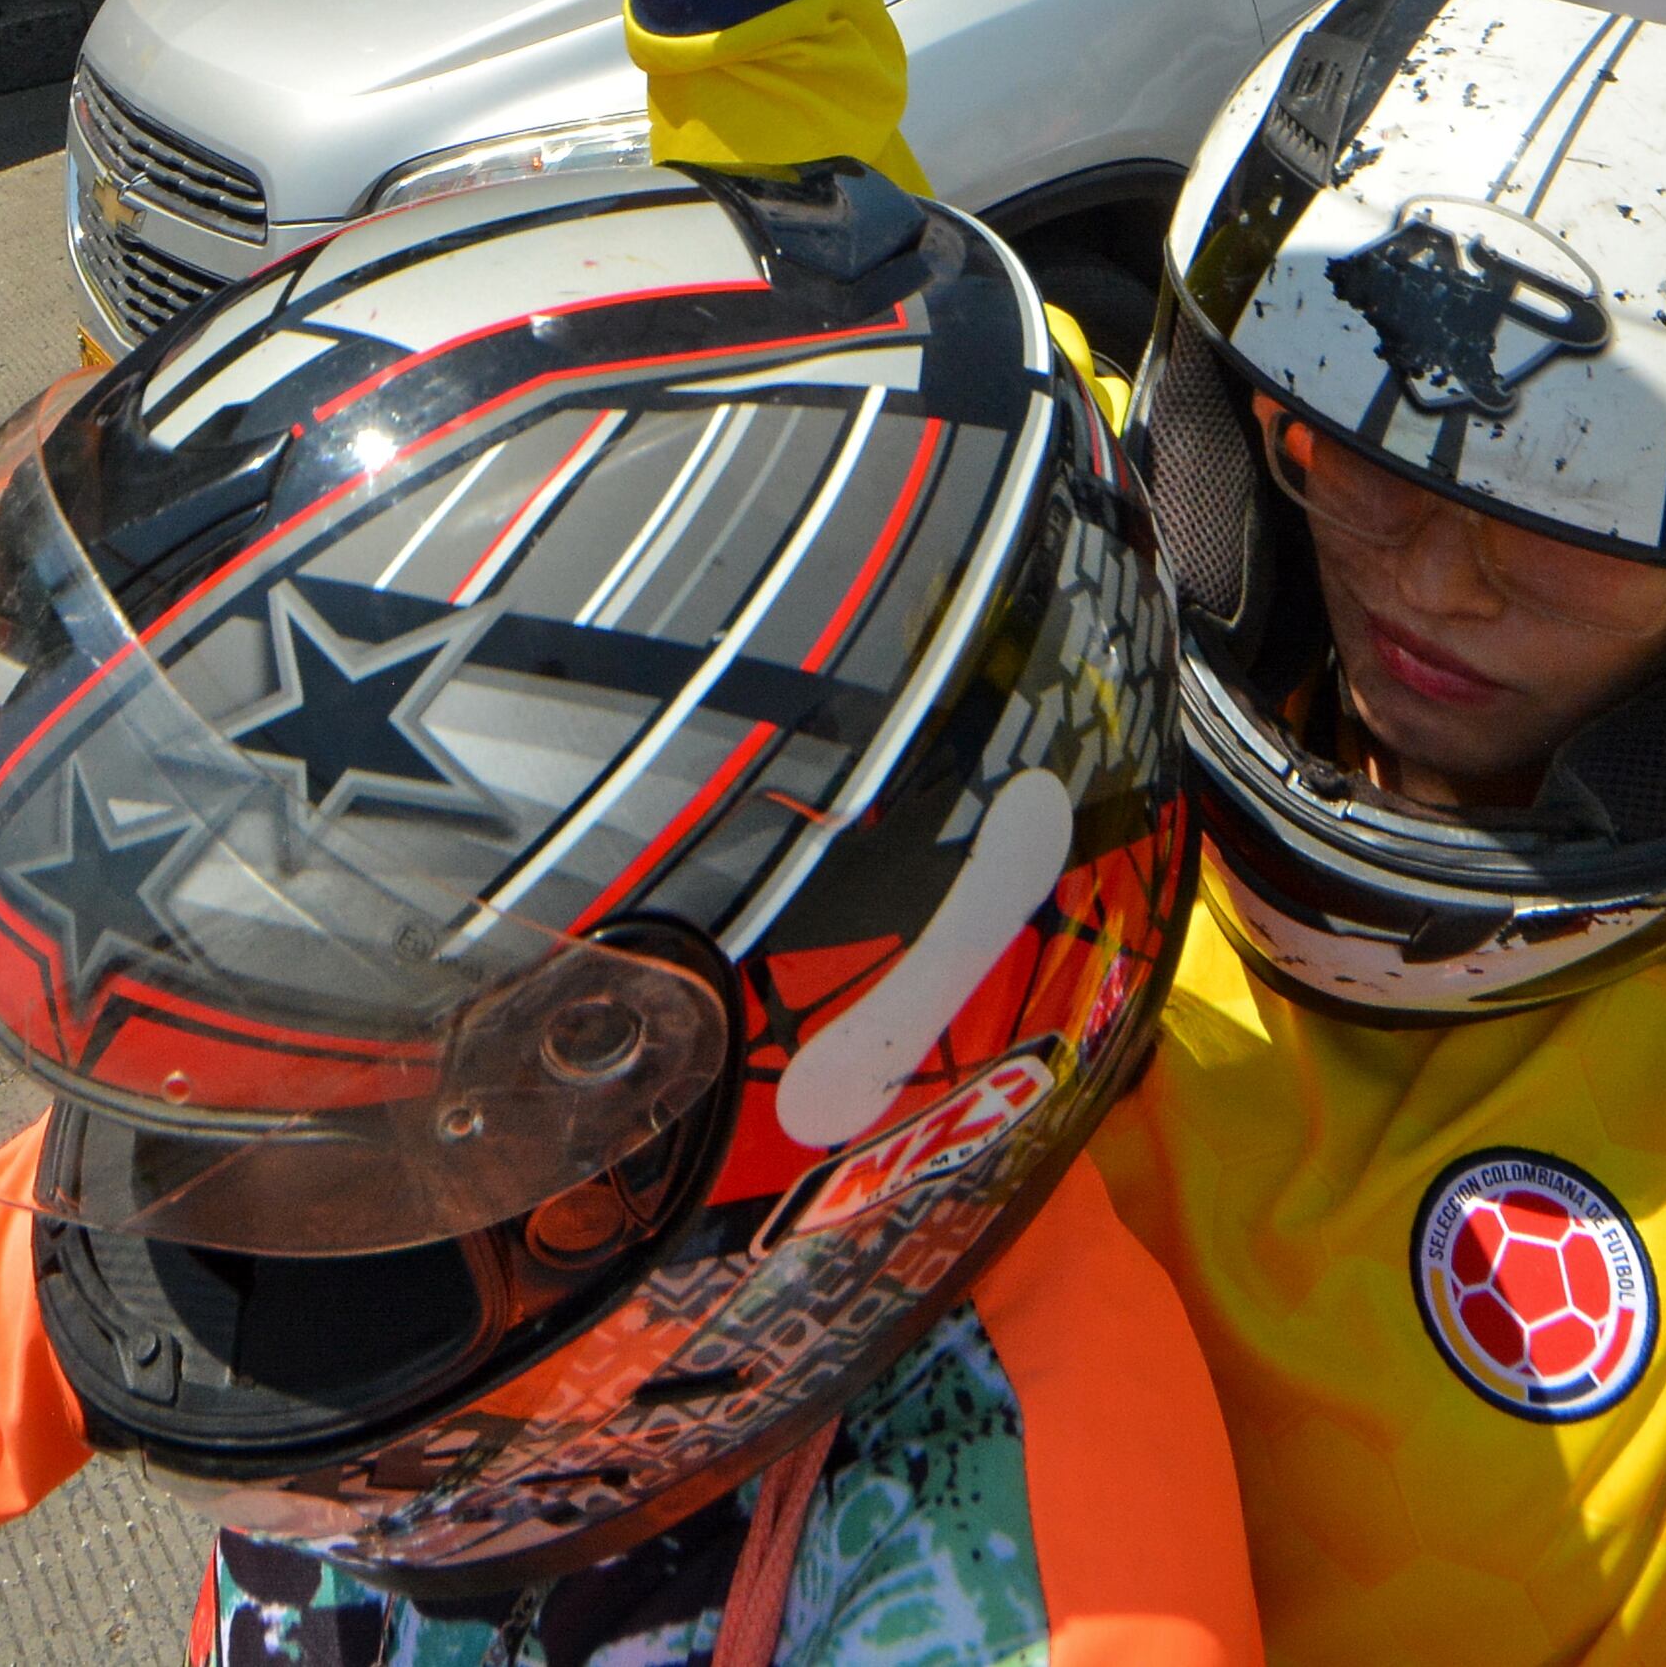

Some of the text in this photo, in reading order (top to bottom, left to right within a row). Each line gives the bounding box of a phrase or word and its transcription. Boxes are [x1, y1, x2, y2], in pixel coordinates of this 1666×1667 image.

[1428, 1162, 1637, 1302] SELECCION COLOMBIANA DE FUTBOL
